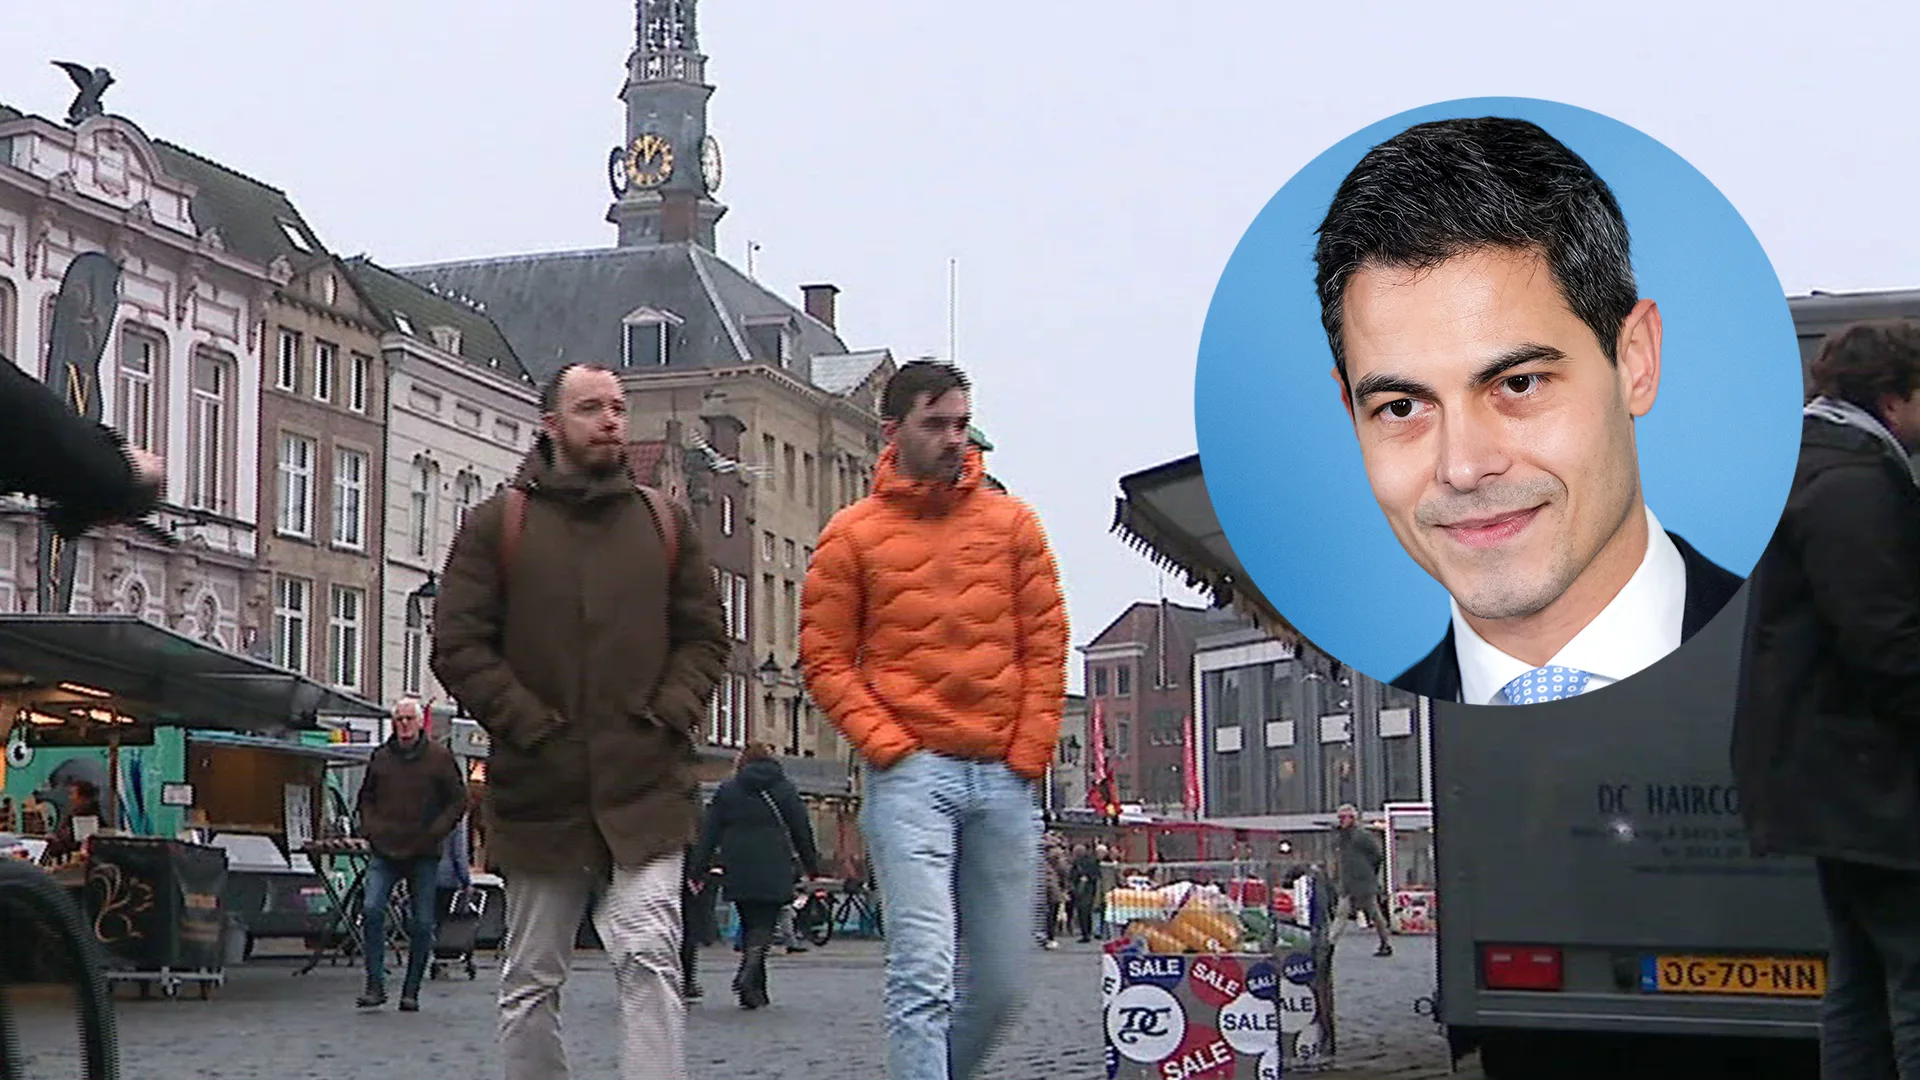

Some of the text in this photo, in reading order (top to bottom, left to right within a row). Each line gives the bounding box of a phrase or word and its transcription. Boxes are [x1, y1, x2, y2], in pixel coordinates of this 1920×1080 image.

[1598, 784, 1741, 816] DC HAIRCO
[1128, 958, 1181, 977] SALE
[1284, 961, 1314, 977] SALE
[1664, 962, 1816, 990] OG-70-NN
[1192, 962, 1240, 998] SALE
[1280, 997, 1313, 1013] ALE
[1222, 1013, 1278, 1031] SALE
[1162, 1040, 1232, 1080] SALE
